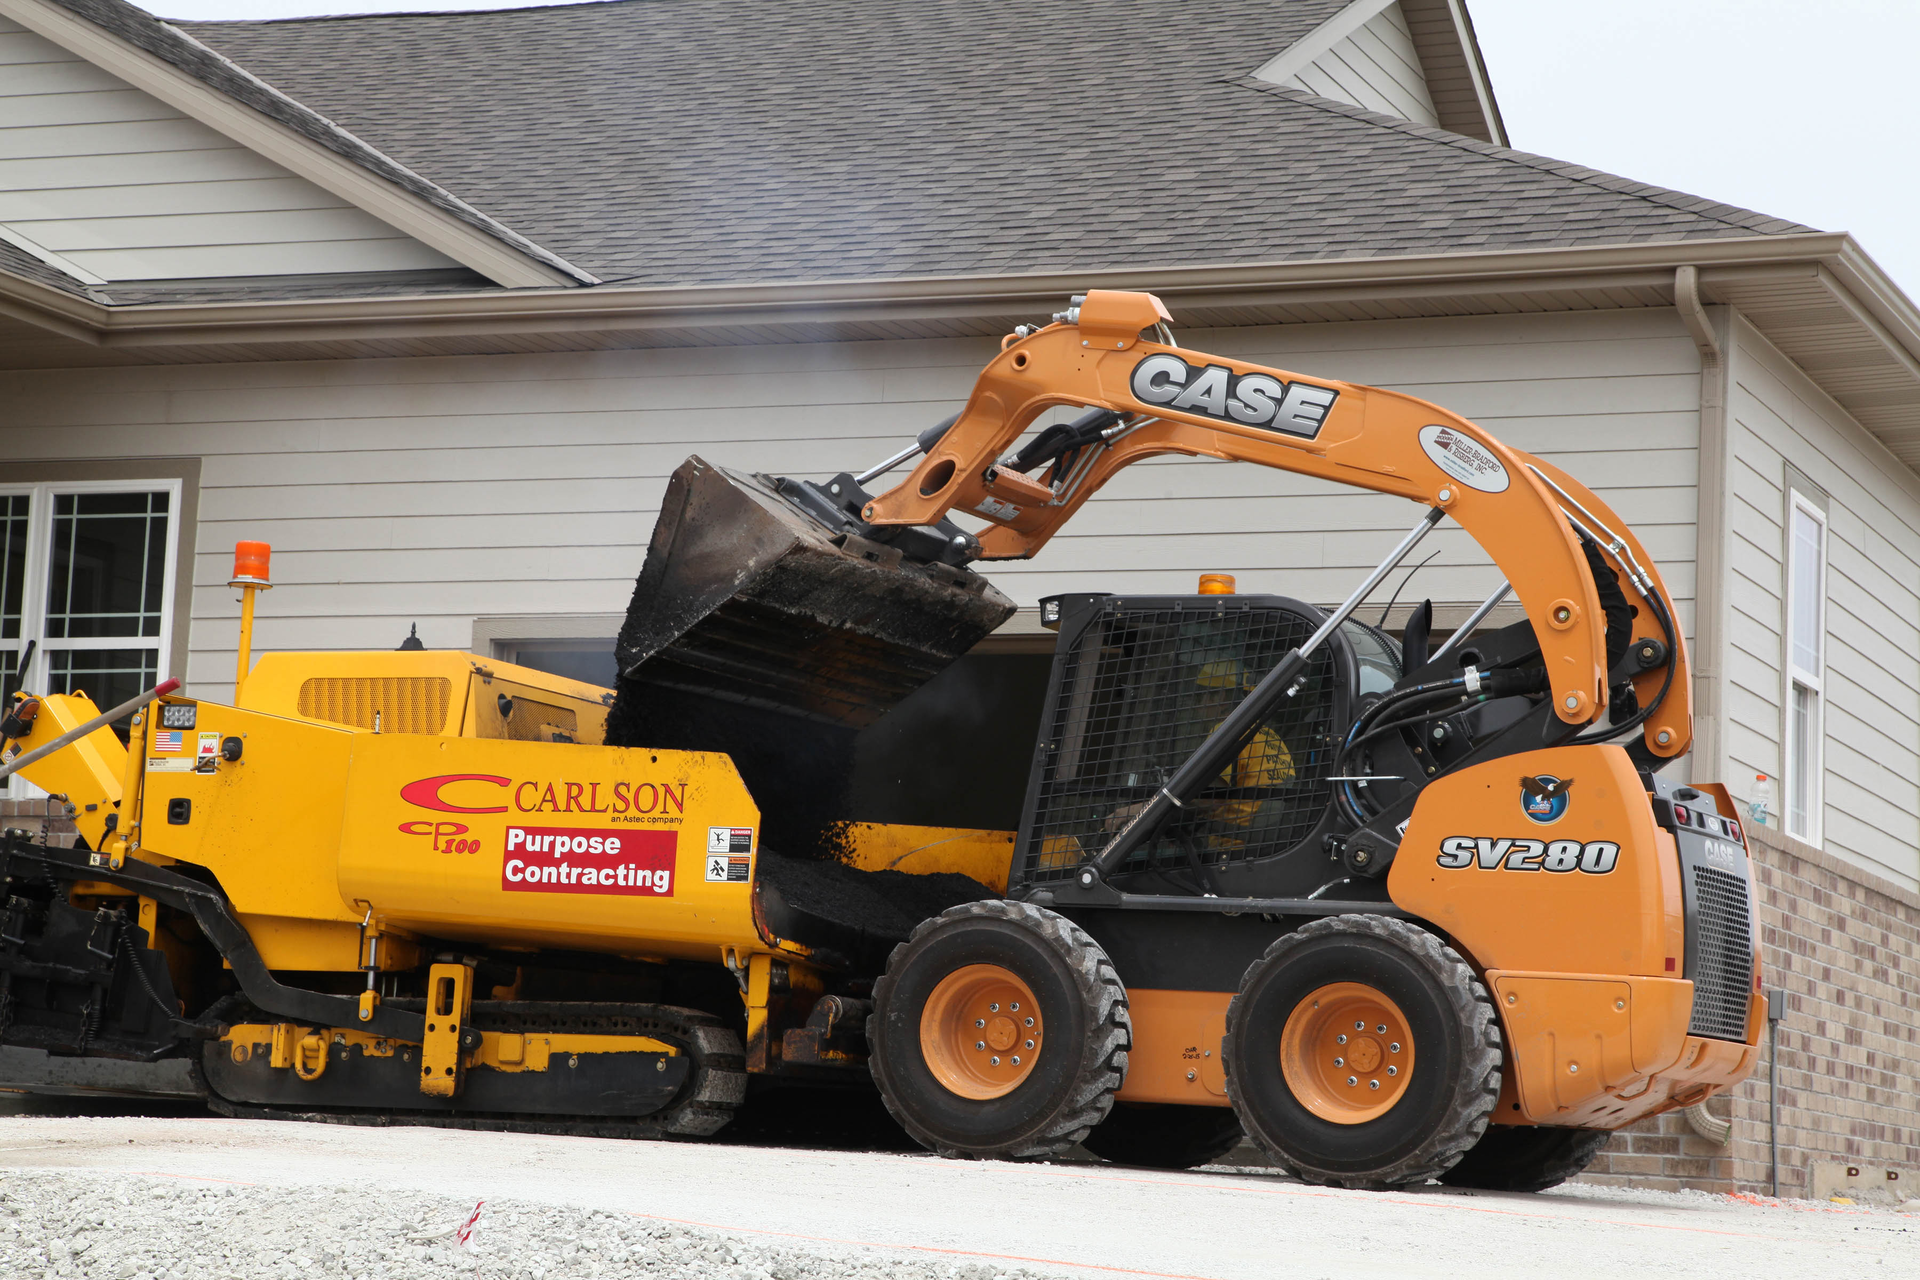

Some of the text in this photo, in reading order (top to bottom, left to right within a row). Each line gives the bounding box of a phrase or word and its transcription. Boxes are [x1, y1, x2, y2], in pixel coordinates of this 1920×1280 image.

[1132, 355, 1336, 436] CASE
[1452, 437, 1501, 473] MILLER-BRADFORD
[515, 781, 688, 814] CARLSON
[623, 815, 646, 824] Astec
[647, 817, 684, 826] company
[507, 829, 621, 858] Purpose
[1437, 836, 1620, 873] SV280
[1704, 839, 1735, 868] CASE
[505, 860, 670, 893] Contracting
